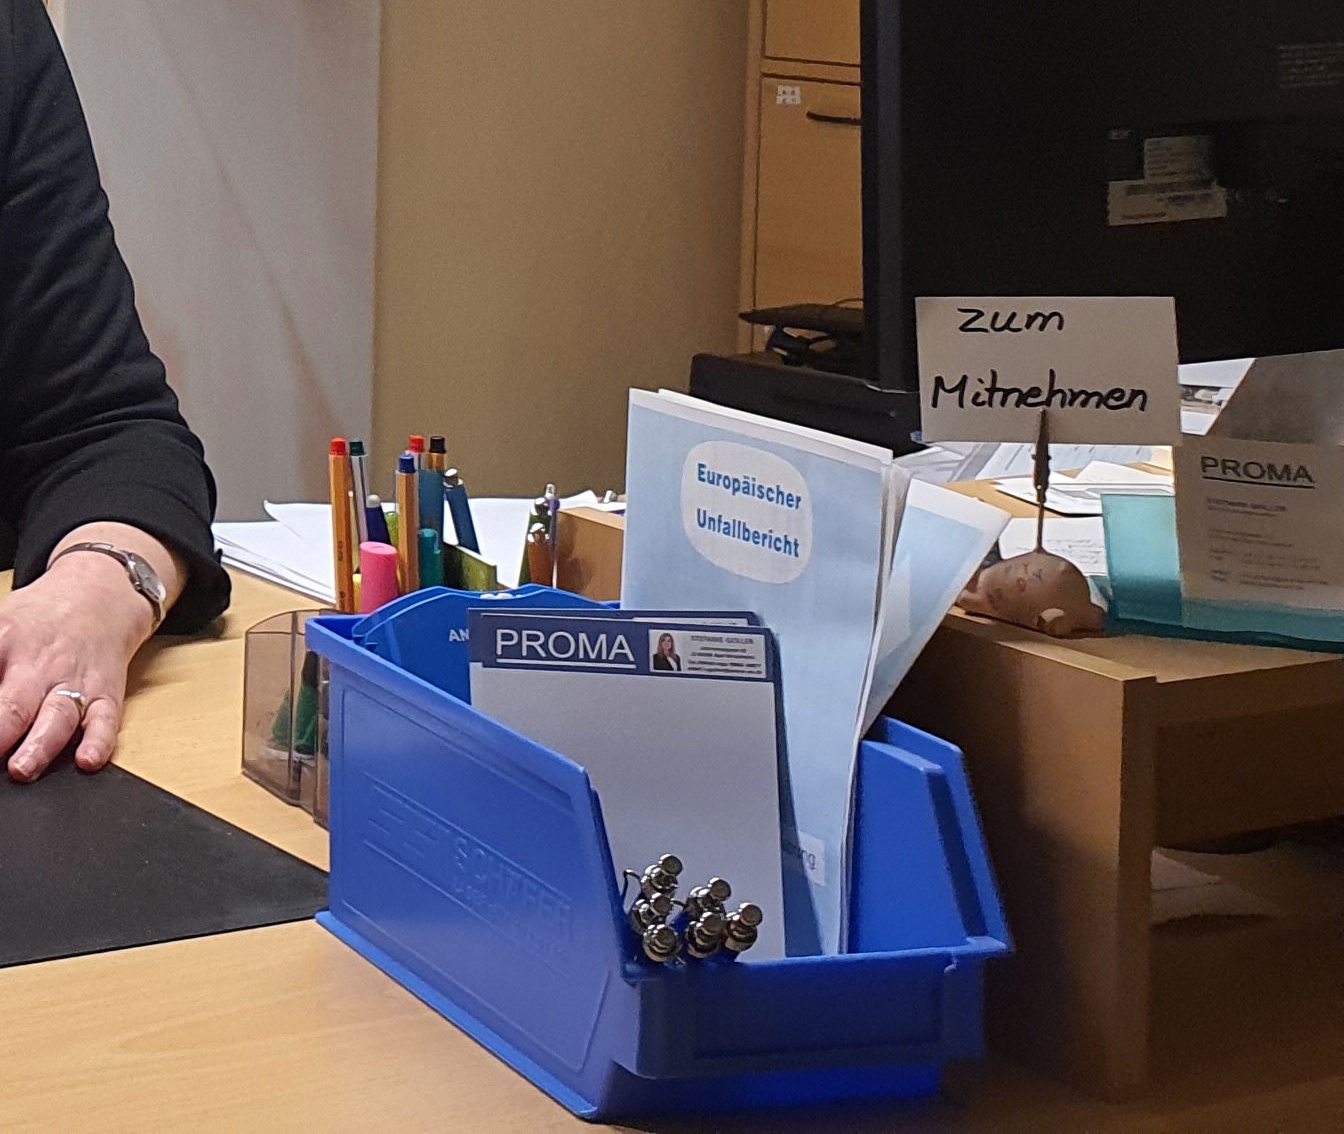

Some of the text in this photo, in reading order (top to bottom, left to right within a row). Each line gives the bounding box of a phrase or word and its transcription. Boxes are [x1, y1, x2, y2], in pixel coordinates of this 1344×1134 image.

[931, 368, 1148, 412] Mitnehmen
[697, 462, 802, 509] Europäischer
[1200, 455, 1315, 484] PROMA
[696, 508, 800, 558] Unfallbericht
[495, 628, 635, 662] PROMA
